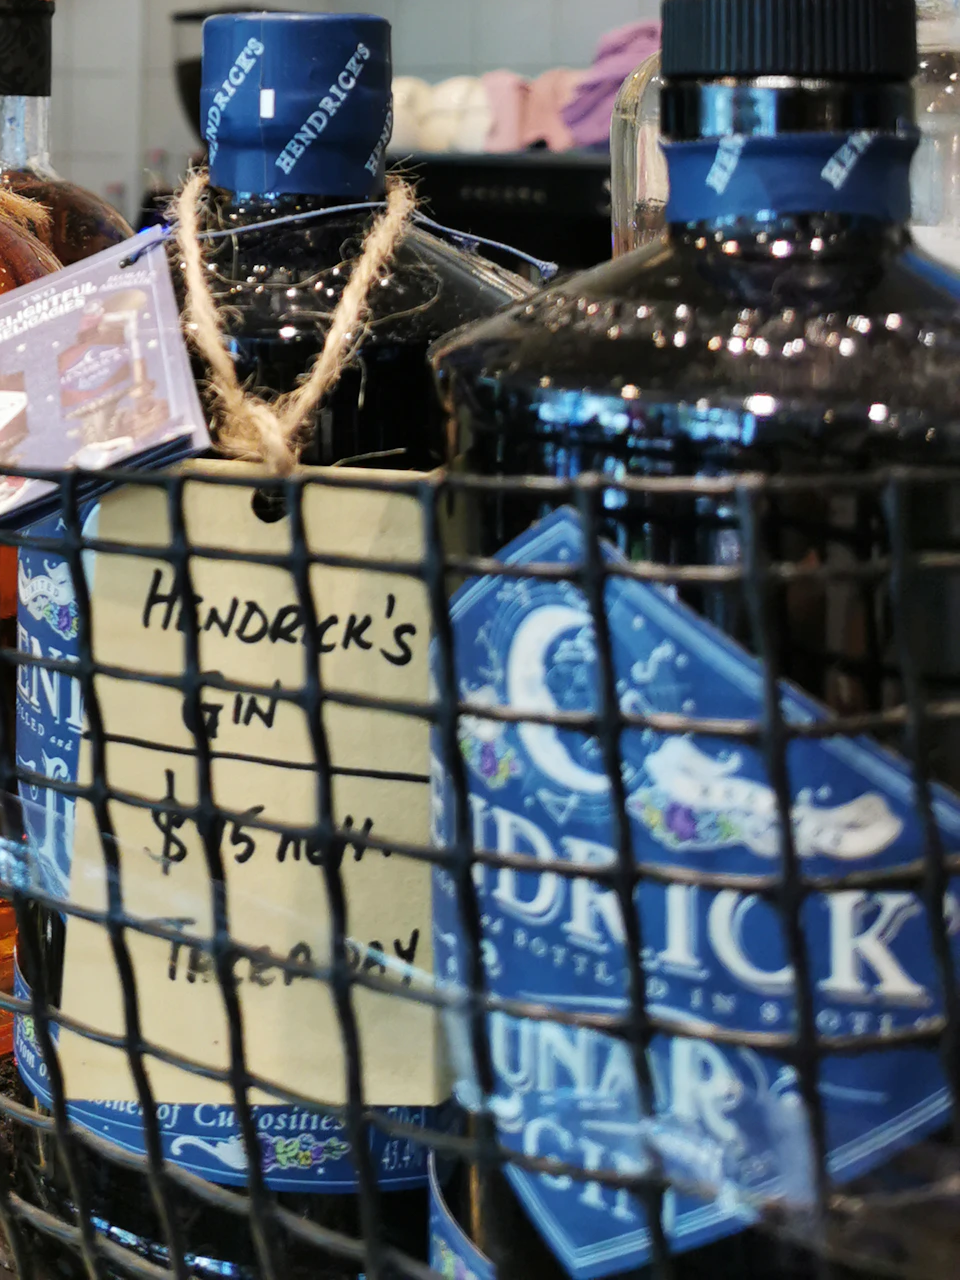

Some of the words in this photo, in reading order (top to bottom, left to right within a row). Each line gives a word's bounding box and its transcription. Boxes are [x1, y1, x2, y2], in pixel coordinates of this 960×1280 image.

[275, 42, 371, 176] HENDRICK'S
[143, 568, 417, 666] HNDRCK'S
[49, 734, 73, 752] and
[512, 926, 669, 999] BOTTLD
[192, 1102, 348, 1132] Cuiosities
[491, 1010, 745, 1144] UNAR
